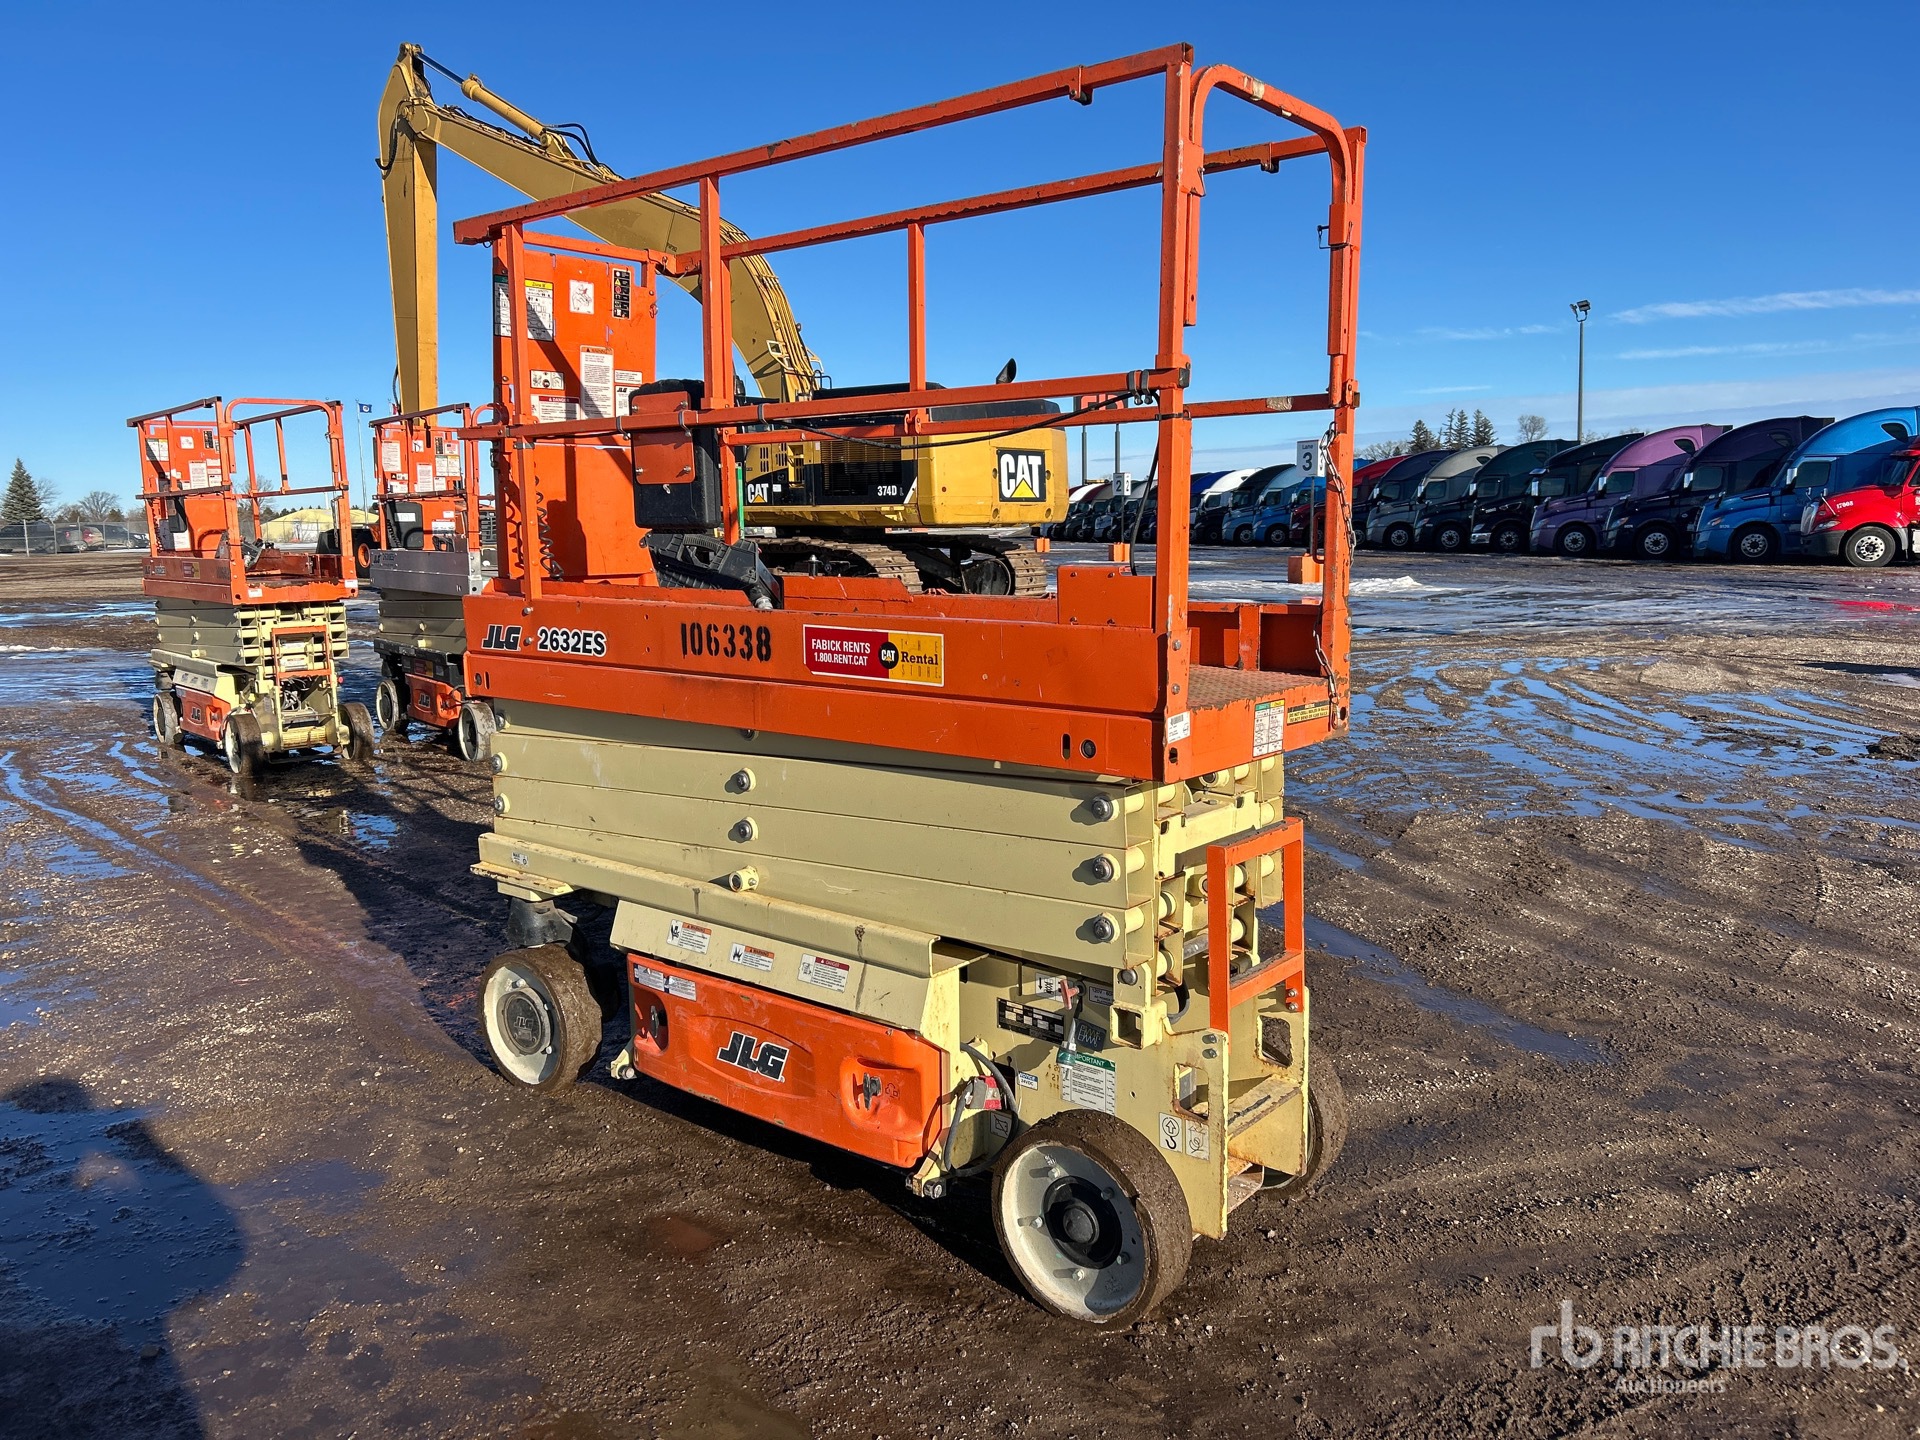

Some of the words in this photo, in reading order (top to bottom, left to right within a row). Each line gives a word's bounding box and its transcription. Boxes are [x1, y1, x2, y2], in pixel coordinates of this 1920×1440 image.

[1302, 452, 1313, 471] 3
[1000, 453, 1042, 498] CAT
[747, 483, 769, 503] CAT
[877, 486, 898, 496] 374D
[1116, 480, 1122, 492] 2
[482, 624, 522, 651] JLG
[537, 626, 607, 657] 2632ES
[680, 622, 772, 662] 106338
[812, 638, 841, 652] FABICK
[843, 641, 871, 655] RENTS
[814, 651, 869, 666] 1.800.RENT.CAT
[881, 649, 895, 662] CAT
[901, 651, 939, 666] Rental
[717, 1031, 789, 1080] JLG
[1076, 1053, 1105, 1067] MPORTANT
